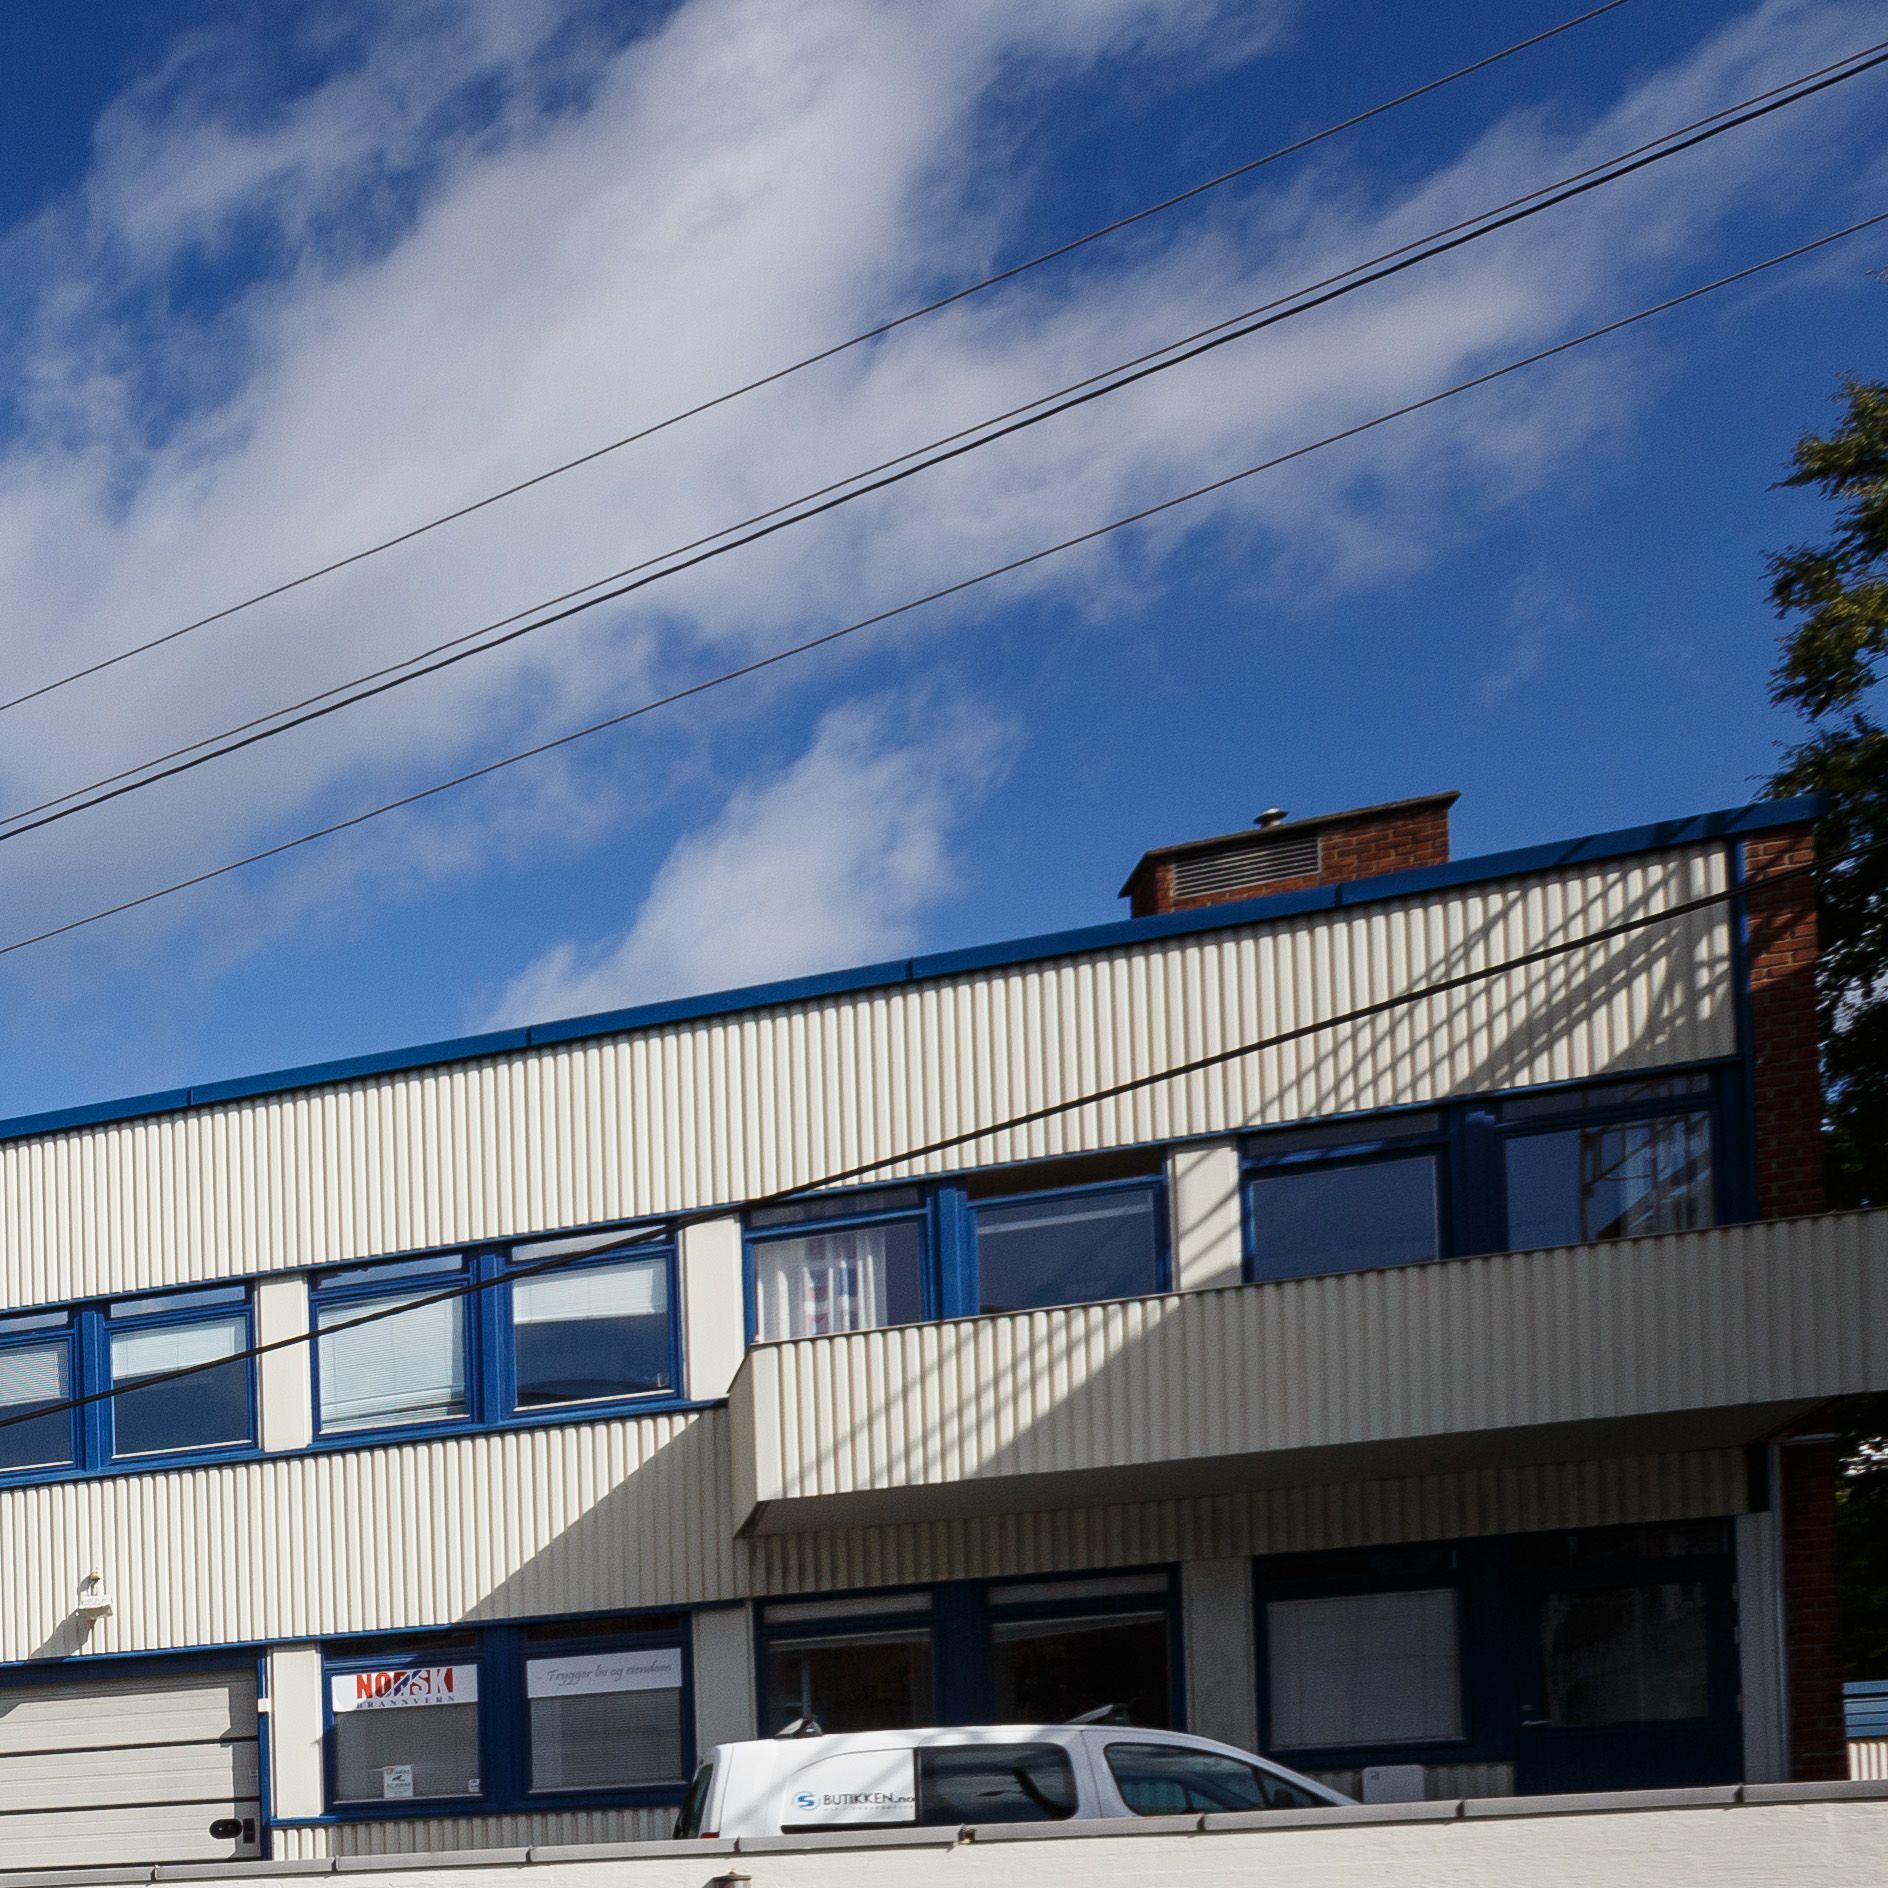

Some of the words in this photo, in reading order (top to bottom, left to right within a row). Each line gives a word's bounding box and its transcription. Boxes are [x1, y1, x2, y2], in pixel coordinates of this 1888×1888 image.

[356, 1668, 453, 1699] NORSK
[547, 1668, 593, 1687] Trygger
[610, 1666, 624, 1682] og
[625, 1660, 672, 1675] eiendom
[356, 1696, 456, 1709] BRANNVERN
